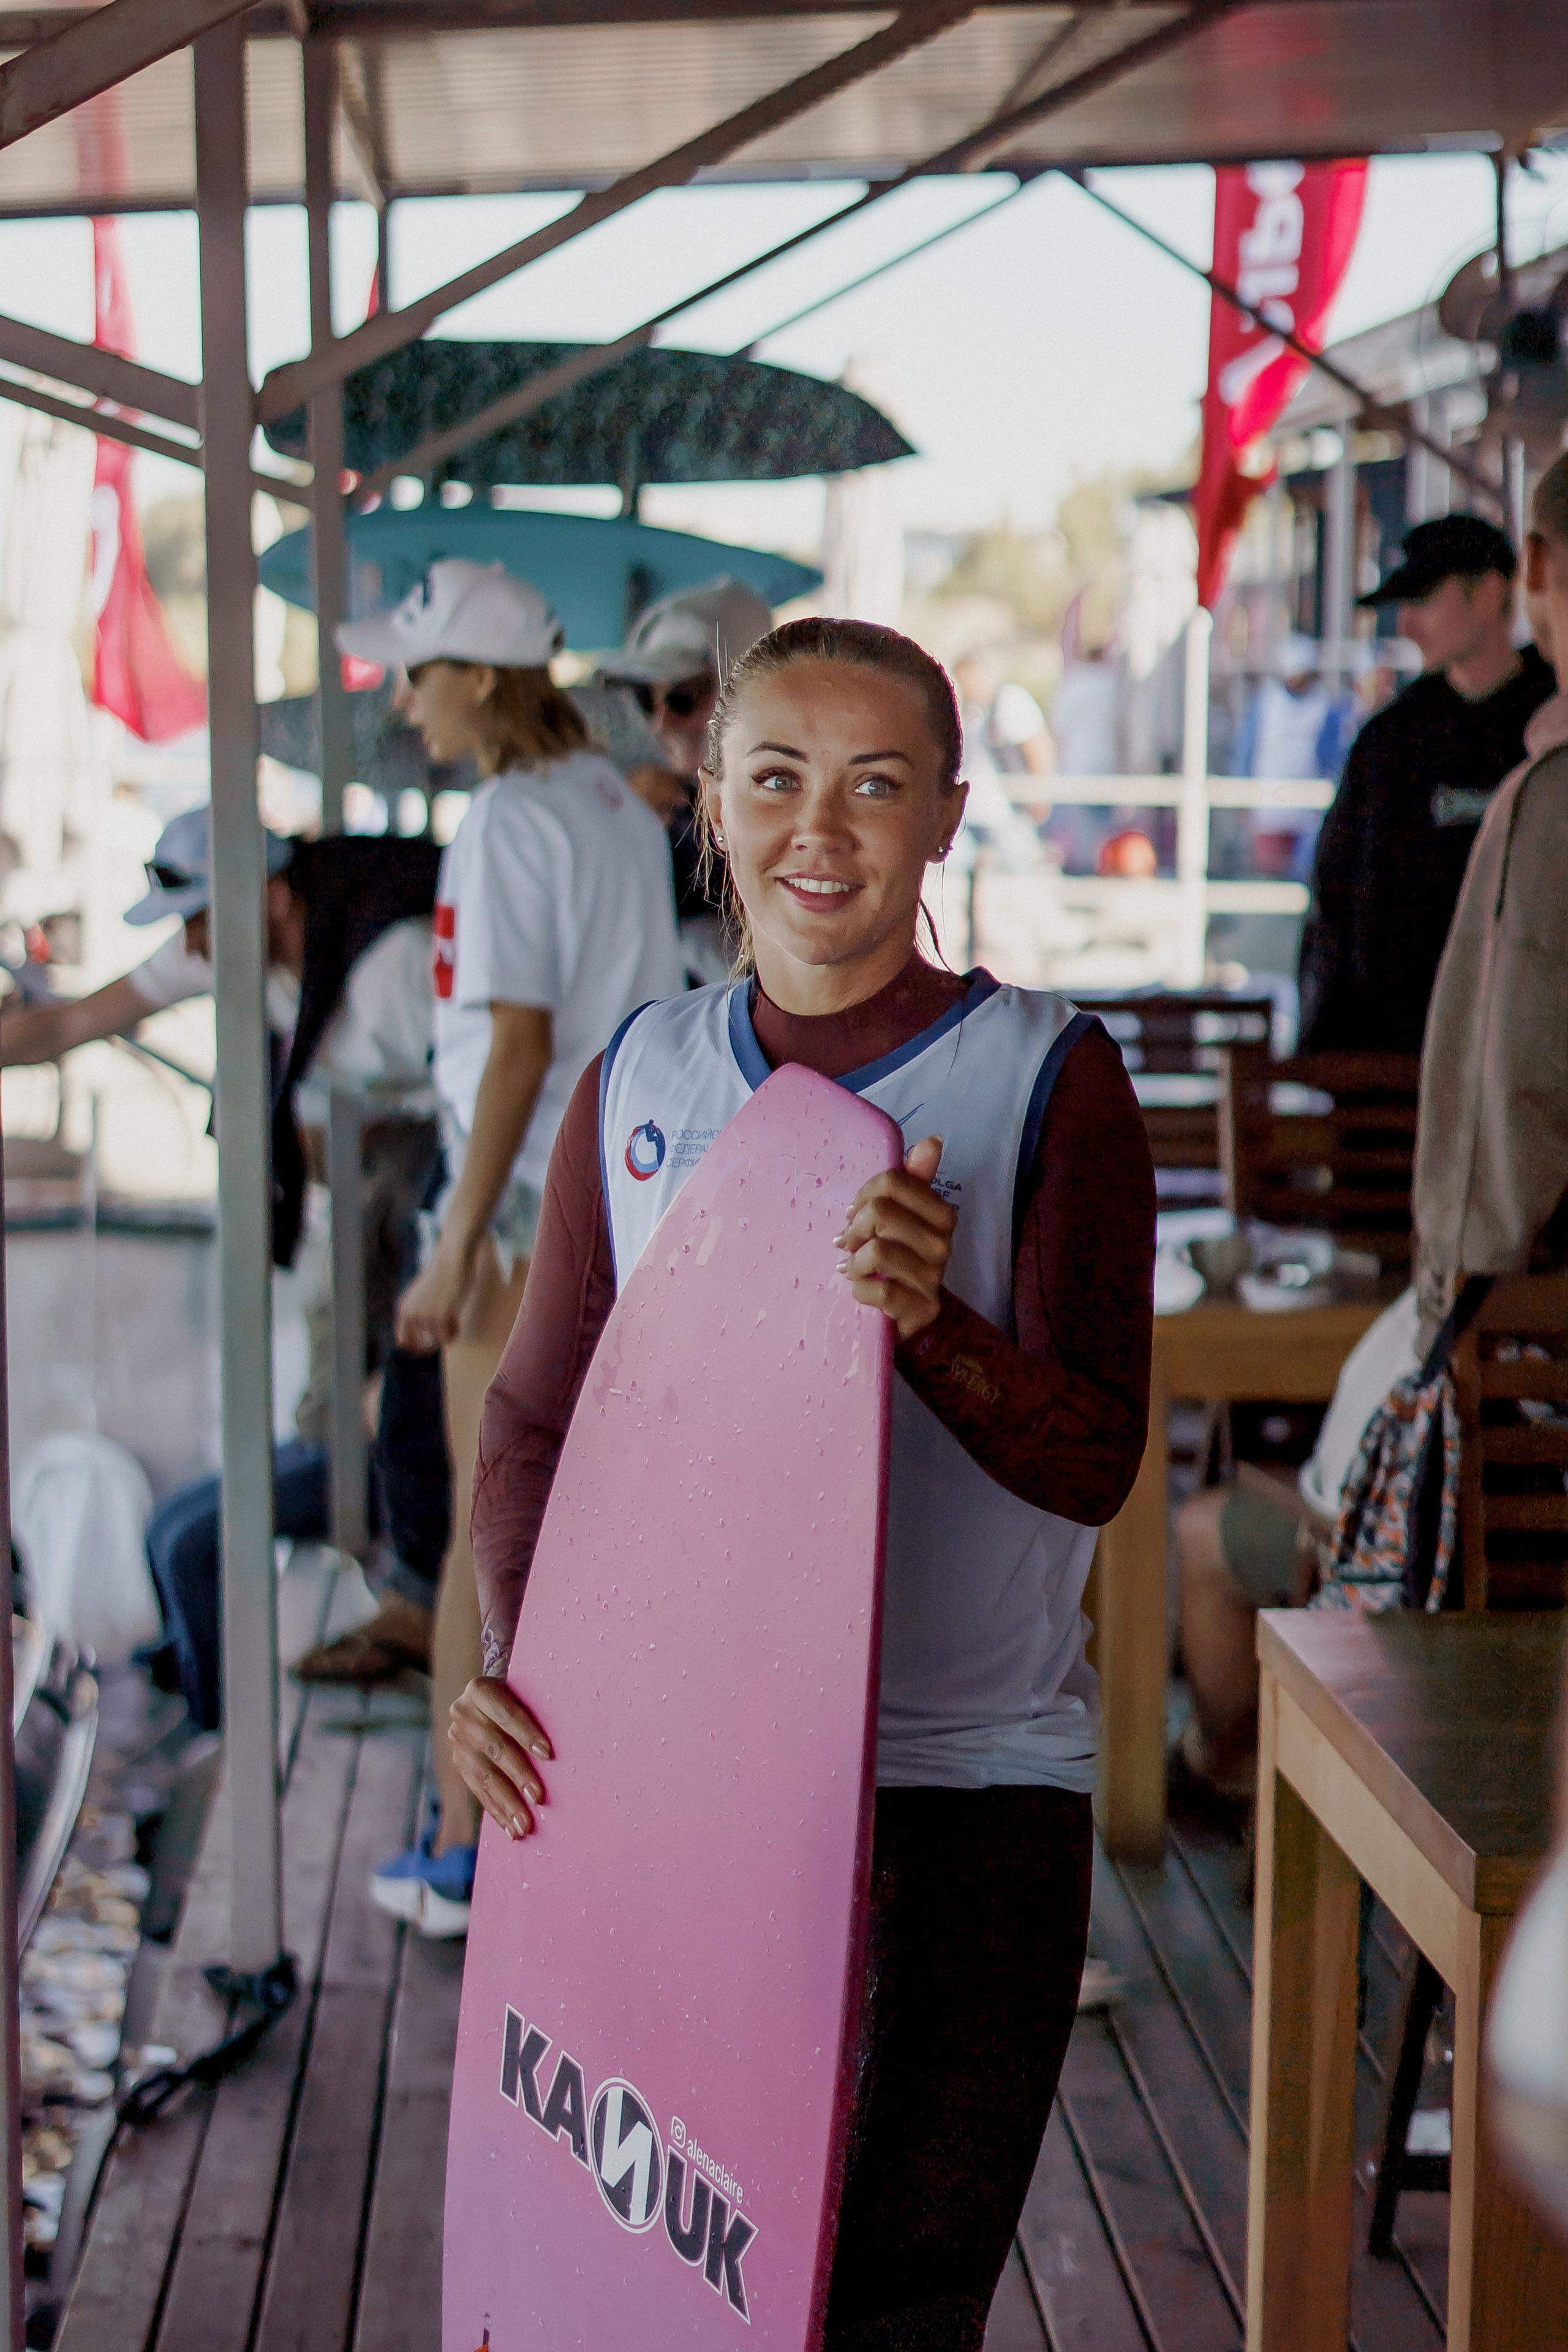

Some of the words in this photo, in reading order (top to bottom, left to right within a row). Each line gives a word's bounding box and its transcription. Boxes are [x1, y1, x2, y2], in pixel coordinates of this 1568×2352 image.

[671, 1128, 722, 1140] РОССИЙС
[669, 1143, 709, 1155] ФЕДЕРА
[666, 1158, 700, 1168] СЕРФИ
[932, 1177, 962, 1192] OLGA
[687, 2138, 744, 2204] alenaclaire
